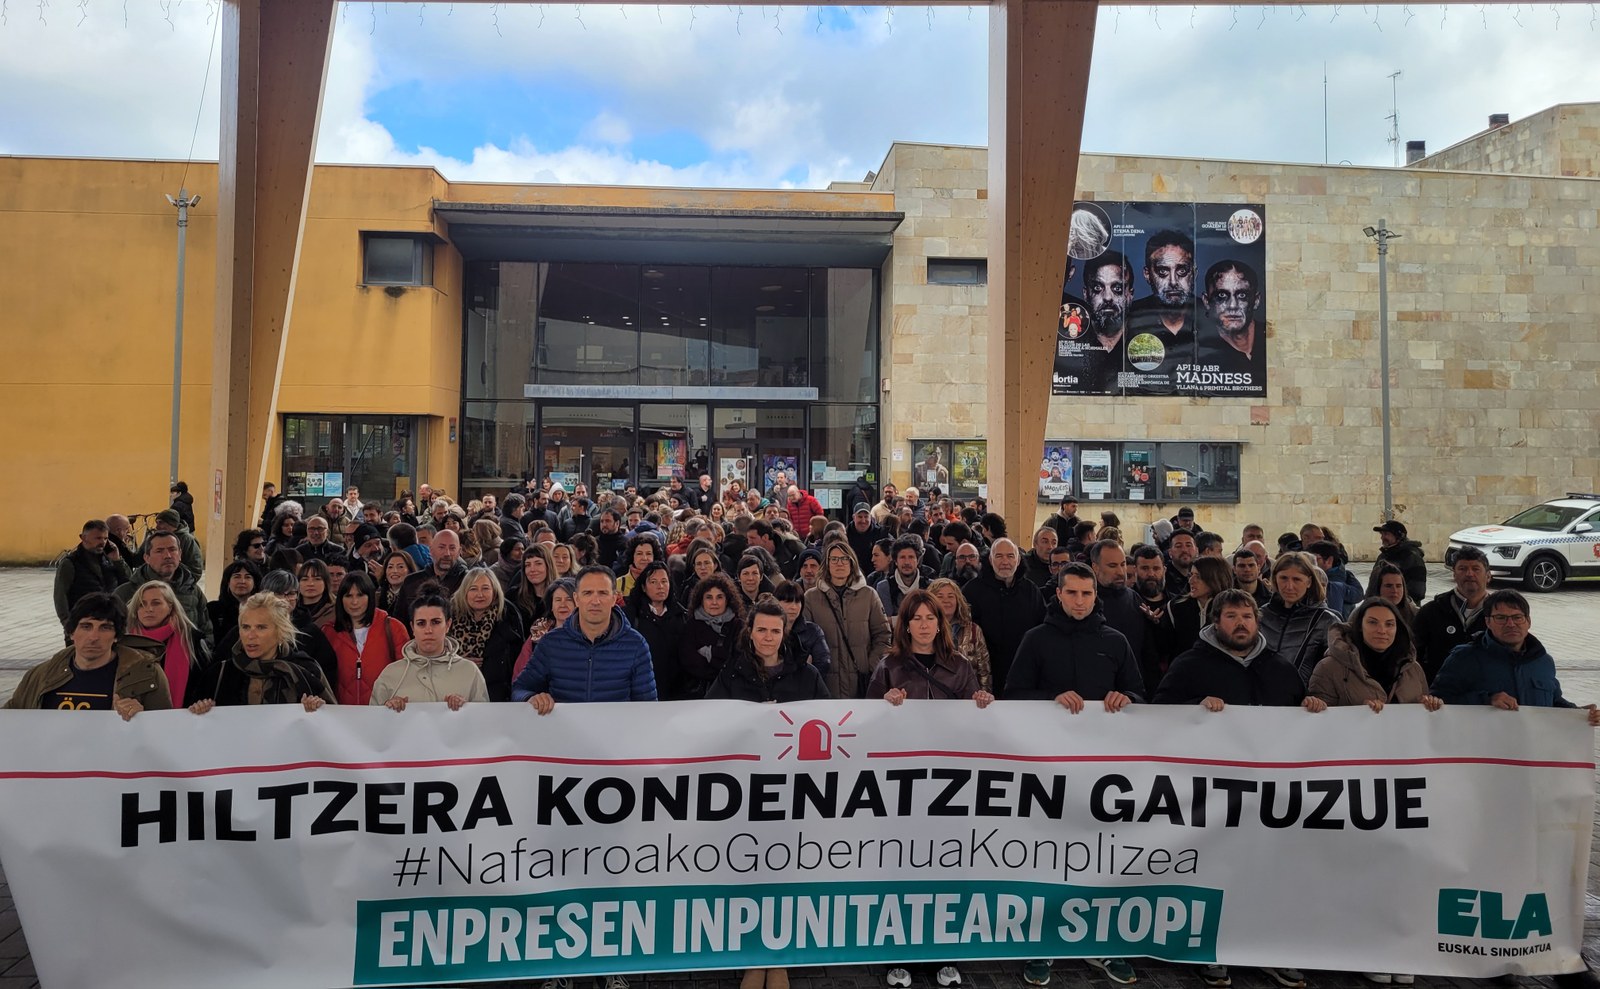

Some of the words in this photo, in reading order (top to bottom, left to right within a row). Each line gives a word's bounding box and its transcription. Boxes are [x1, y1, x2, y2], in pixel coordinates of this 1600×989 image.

[1176, 372, 1253, 385] MADNESS
[1192, 364, 1201, 372] 18
[120, 774, 514, 848] HILTZERA
[537, 768, 1067, 826] KONDENATZEN
[1089, 773, 1430, 831] GAITUZUE
[392, 828, 1199, 888] #NafarroakoGobernuaKonplizea
[378, 899, 656, 967] ENPRESEN
[673, 893, 1045, 953] INPUNITATEARI
[1060, 895, 1206, 945] STOP!
[1437, 888, 1553, 940] ELA
[1438, 942, 1487, 956] EUSKAL
[1490, 943, 1552, 957] SINDIKATUA
